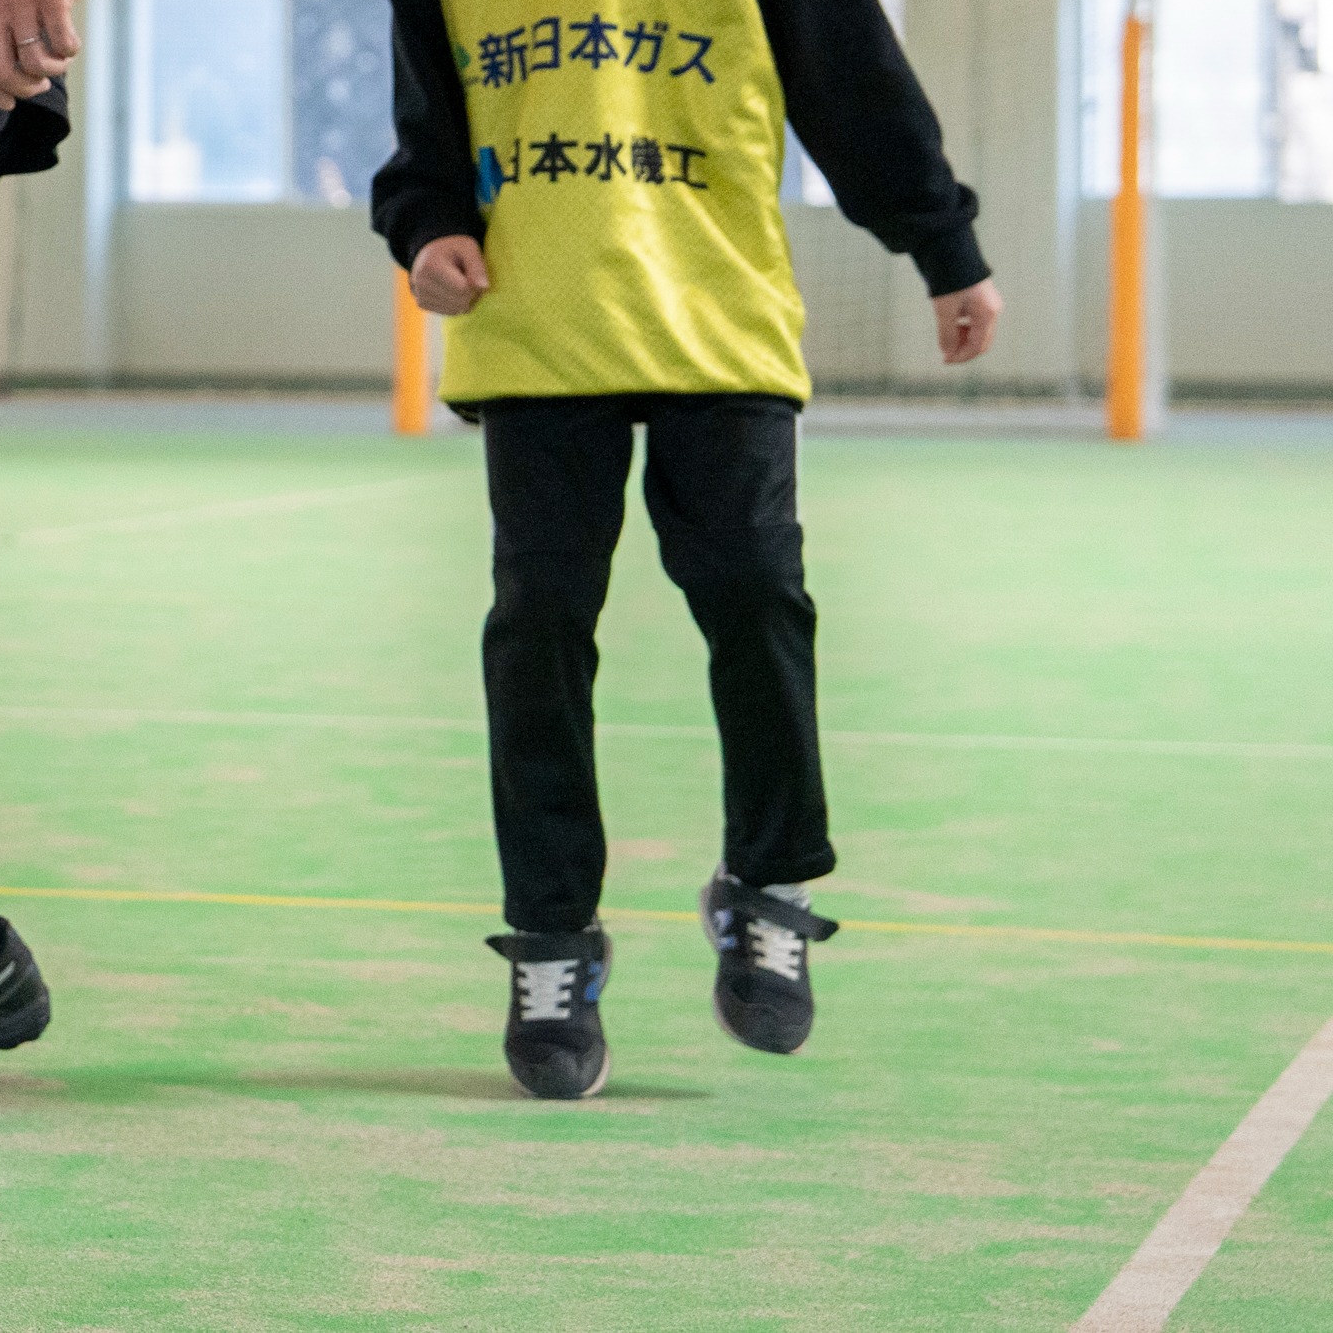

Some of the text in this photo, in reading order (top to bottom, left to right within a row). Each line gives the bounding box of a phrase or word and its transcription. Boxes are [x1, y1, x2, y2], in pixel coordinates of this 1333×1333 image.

[478, 13, 717, 89] 新日本ガス
